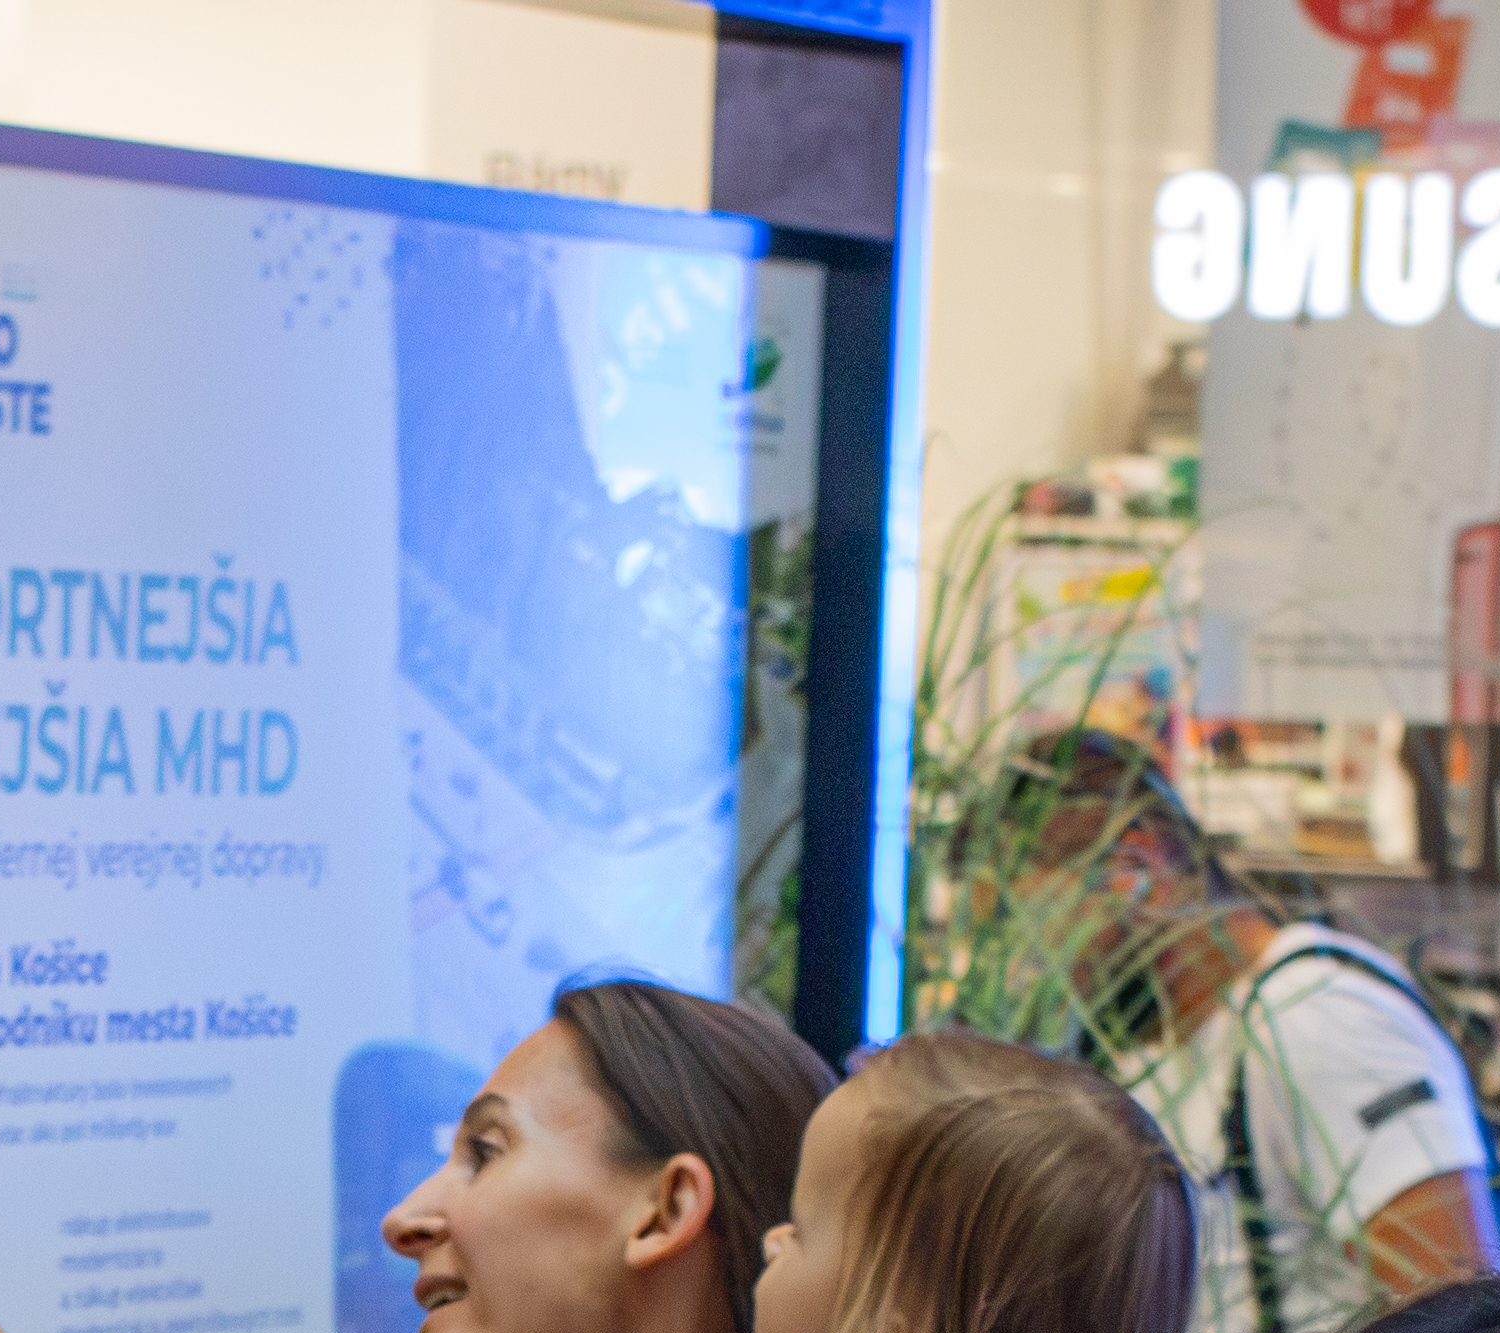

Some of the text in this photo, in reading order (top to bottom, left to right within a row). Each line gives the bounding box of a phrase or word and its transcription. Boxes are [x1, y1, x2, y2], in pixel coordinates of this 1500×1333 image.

[157, 706, 298, 796] MHD
[8, 938, 111, 988] Košice
[106, 1003, 198, 1045] mesta
[204, 993, 298, 1041] Košice
